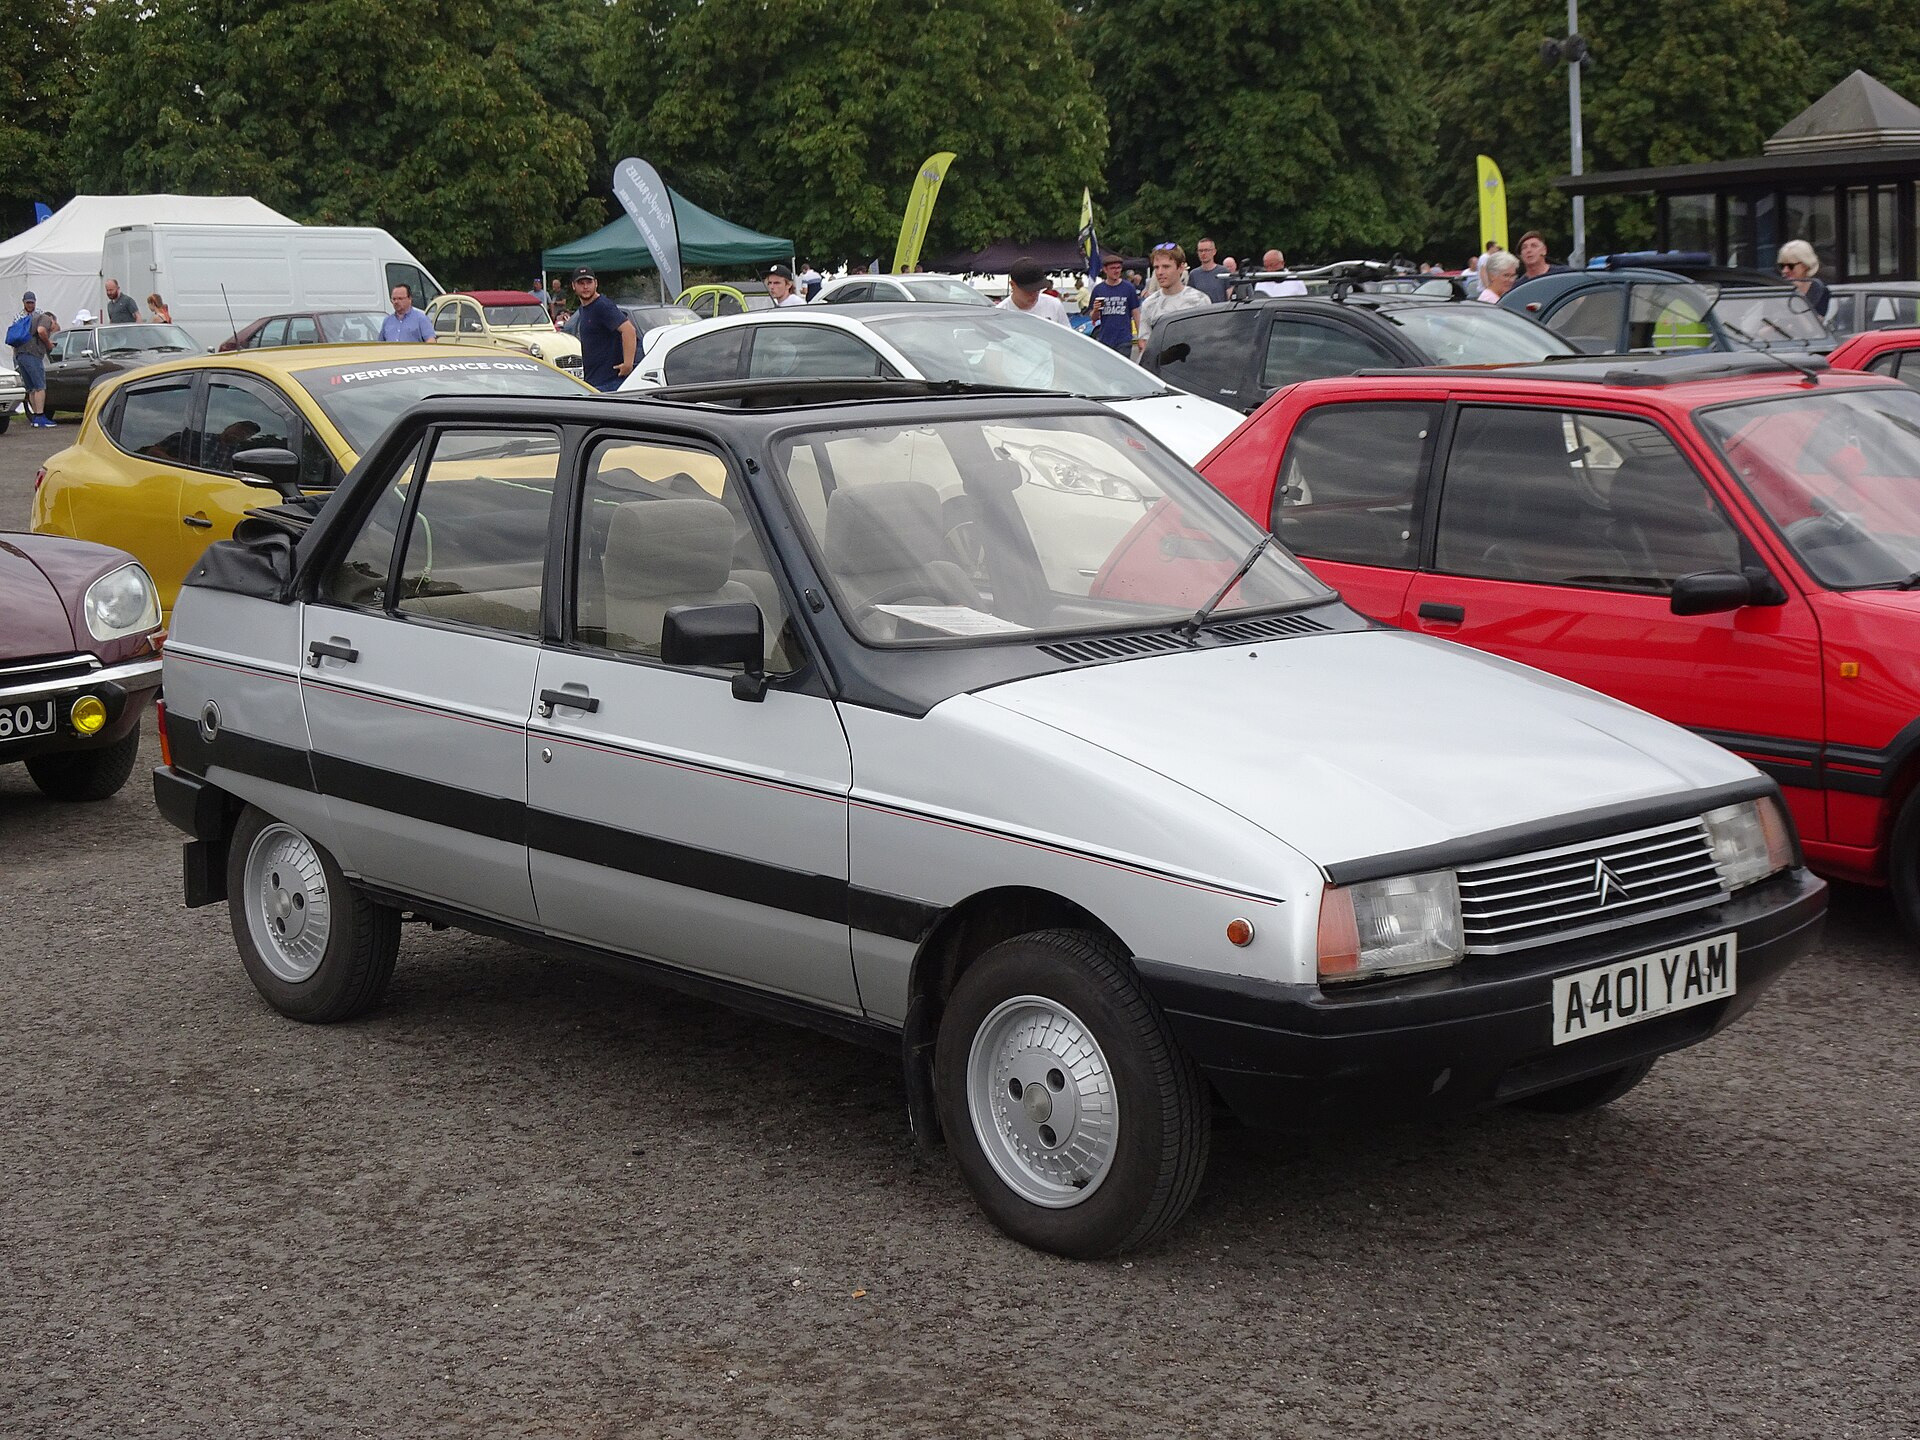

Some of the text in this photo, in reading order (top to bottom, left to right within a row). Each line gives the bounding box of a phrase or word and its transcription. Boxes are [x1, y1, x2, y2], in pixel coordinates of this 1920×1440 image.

[492, 363, 539, 372] ONLY
[1564, 942, 1728, 1034] A401 YAM
